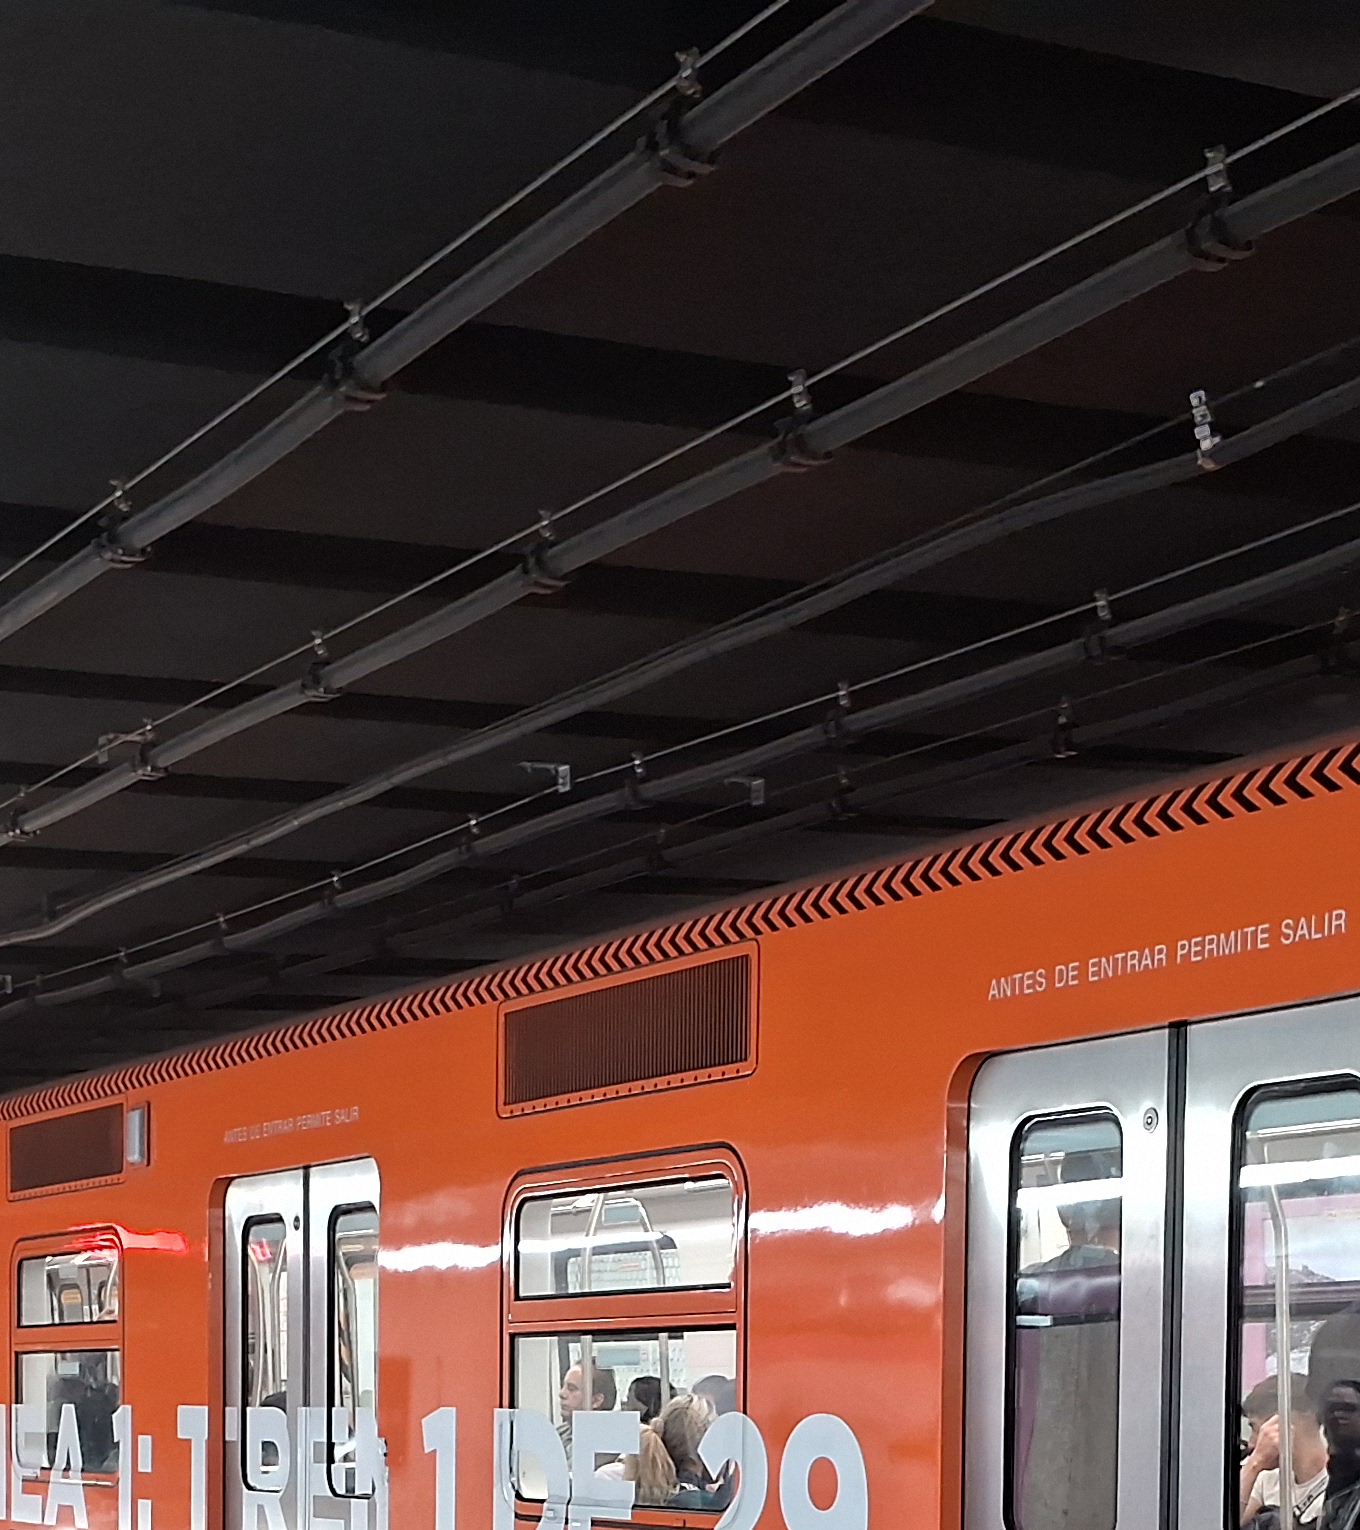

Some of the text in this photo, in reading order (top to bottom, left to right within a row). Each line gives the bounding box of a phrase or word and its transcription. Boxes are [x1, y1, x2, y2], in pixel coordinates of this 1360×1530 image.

[988, 908, 1347, 1001] ANTES DE ENTRAR PERMITE SALIR
